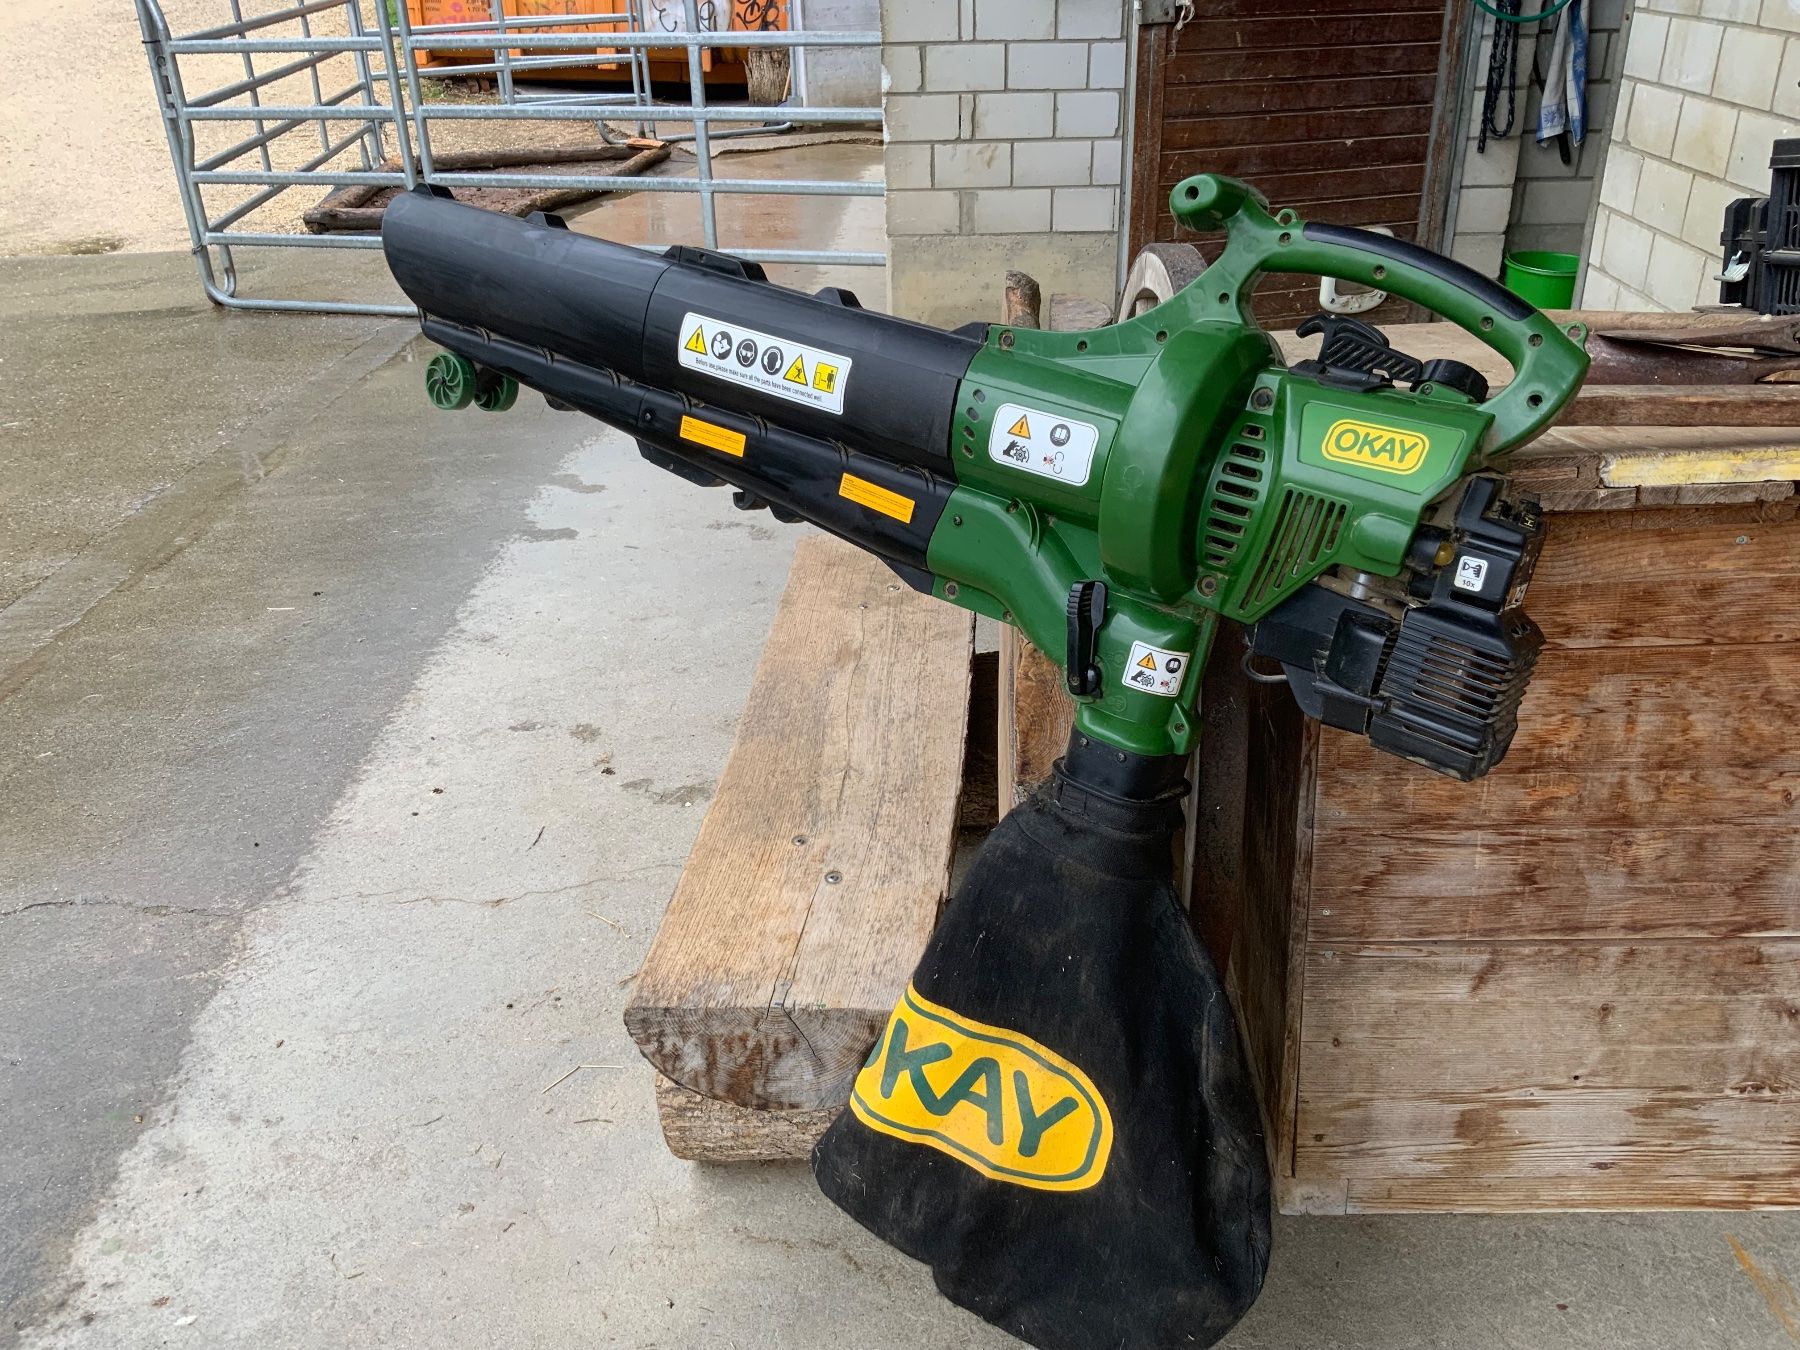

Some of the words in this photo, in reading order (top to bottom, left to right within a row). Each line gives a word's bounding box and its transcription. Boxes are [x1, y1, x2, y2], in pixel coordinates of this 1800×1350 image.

[695, 357, 708, 366] Before
[1335, 429, 1419, 463] OKAY
[1463, 580, 1475, 588] 10x
